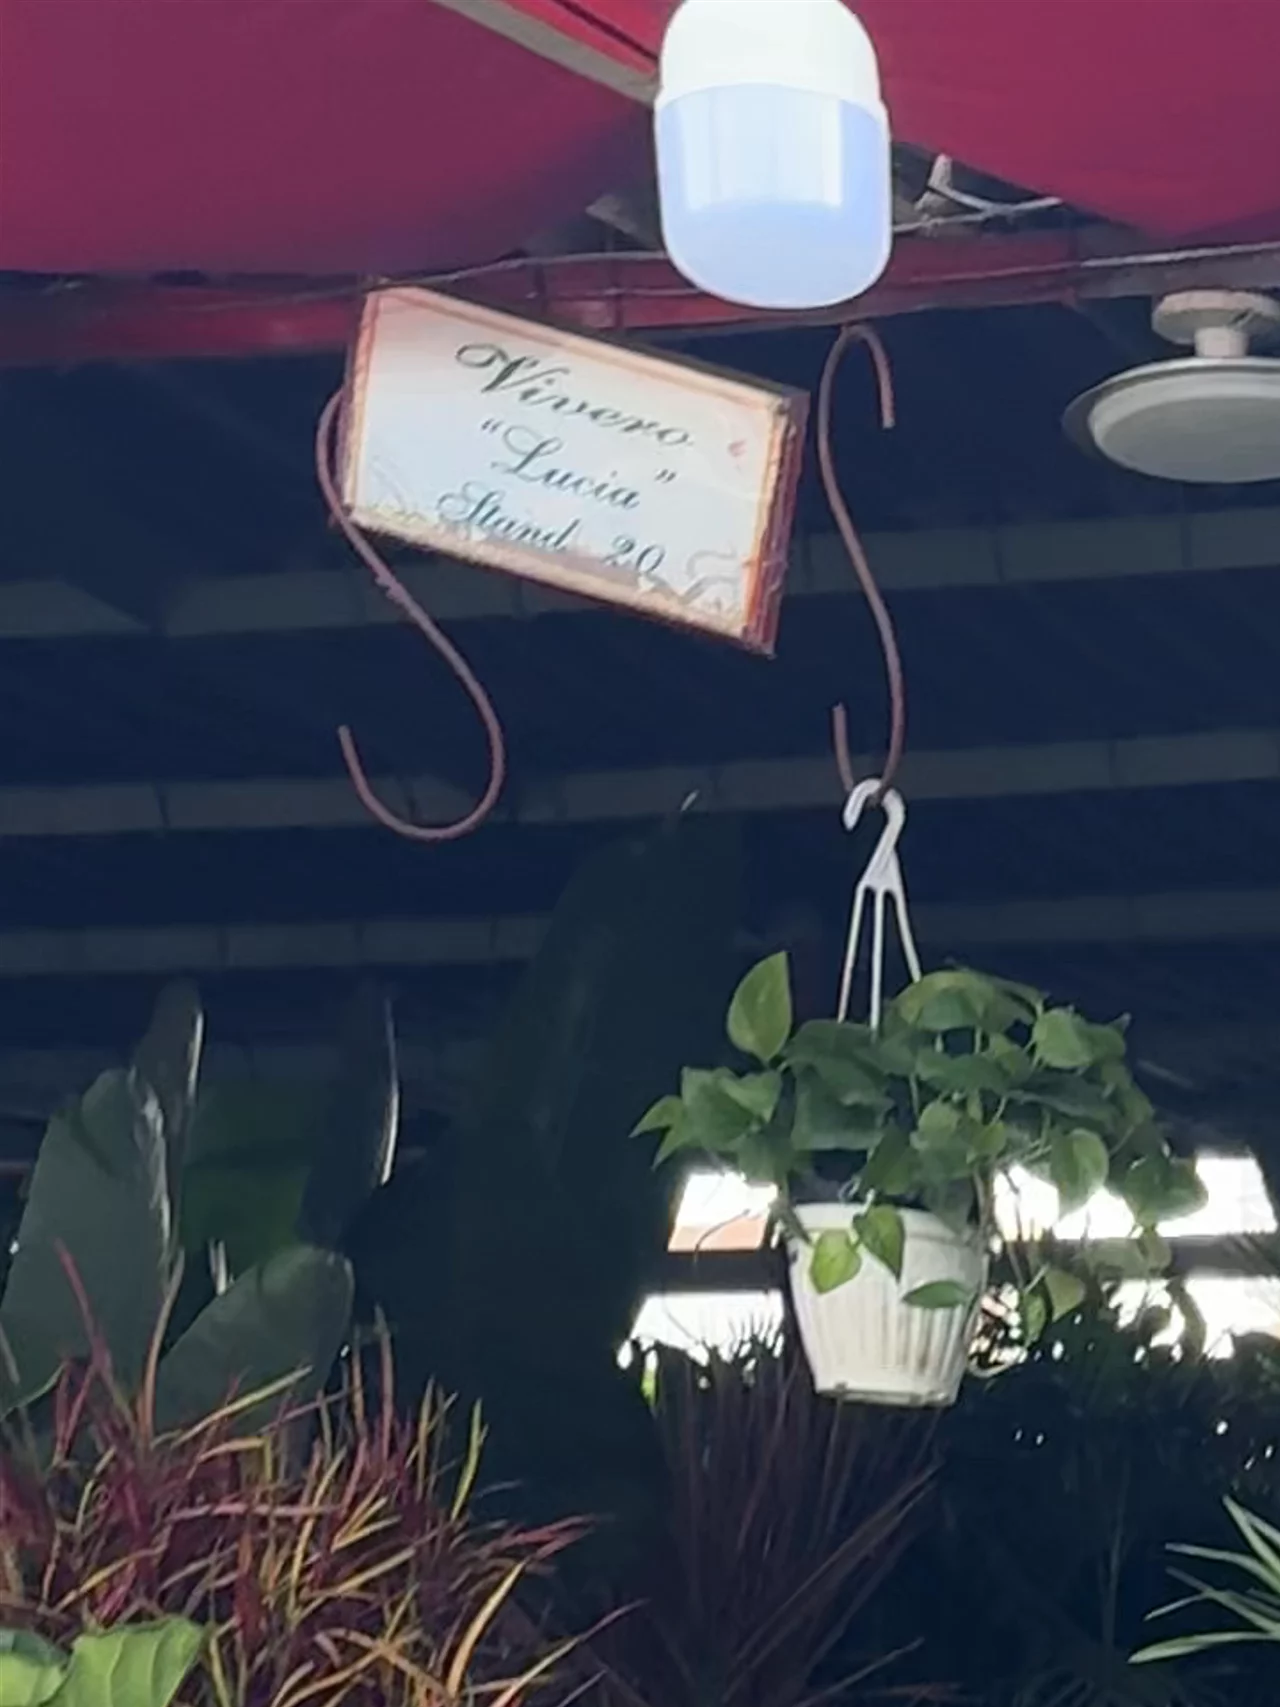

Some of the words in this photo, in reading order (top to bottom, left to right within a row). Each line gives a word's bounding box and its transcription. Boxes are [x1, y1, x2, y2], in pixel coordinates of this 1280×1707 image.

[455, 343, 694, 448] Vivero
[437, 481, 582, 552] Stand
[599, 534, 666, 576] 20
